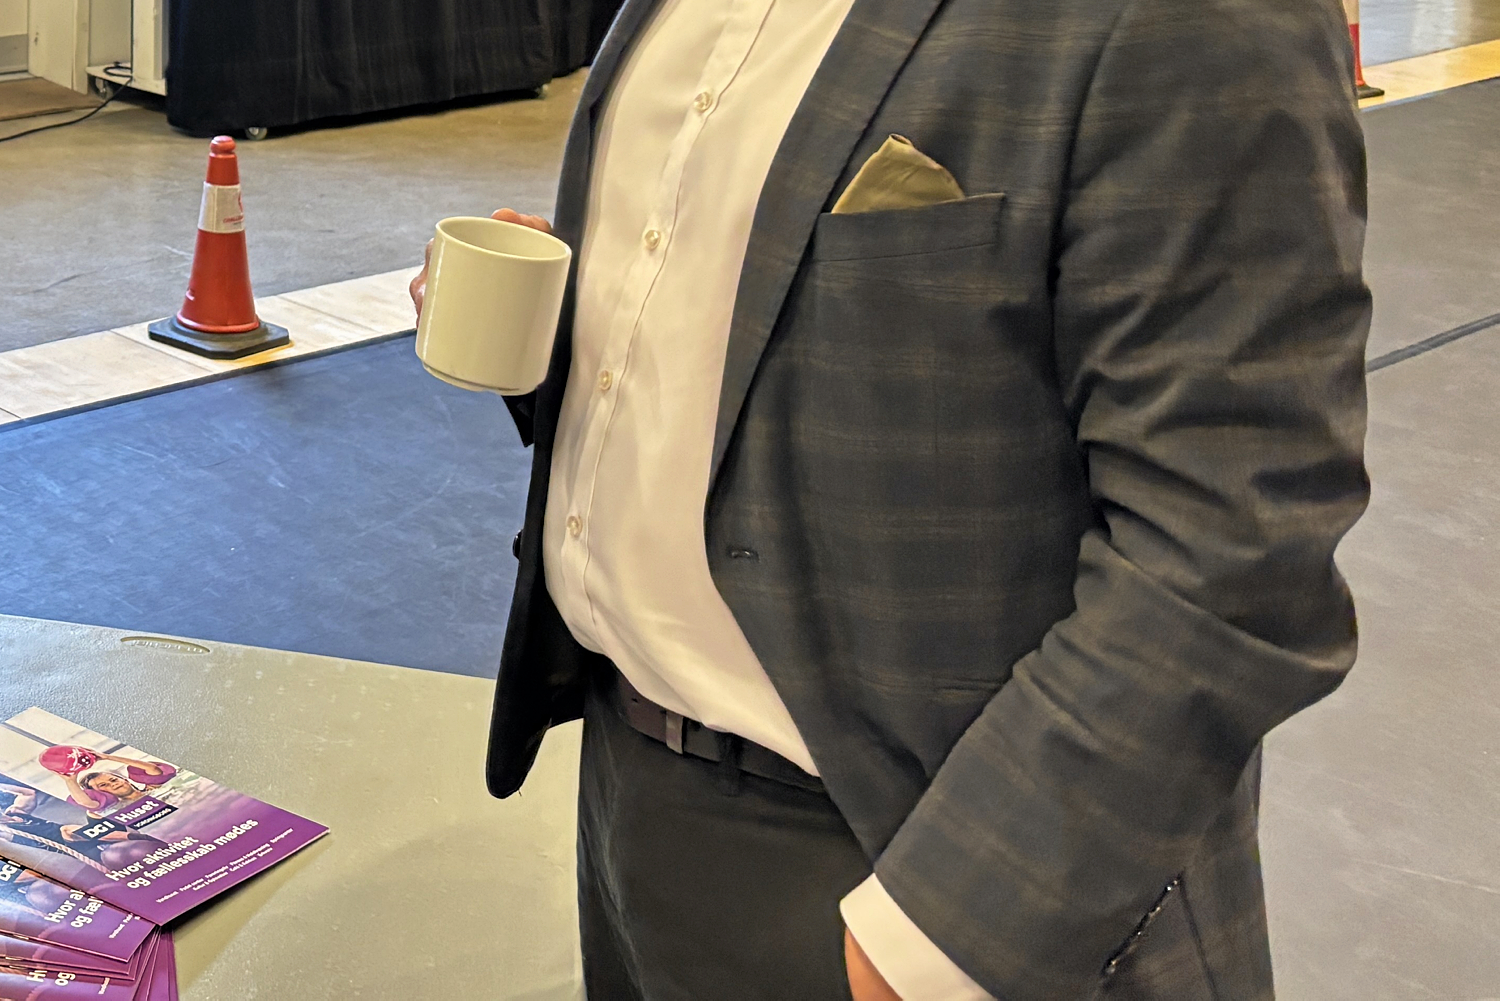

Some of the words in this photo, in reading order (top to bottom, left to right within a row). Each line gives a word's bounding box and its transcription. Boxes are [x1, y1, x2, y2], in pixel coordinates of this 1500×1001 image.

[114, 800, 160, 823] Huset
[83, 820, 115, 839] DGI
[105, 861, 144, 881] Hvor
[142, 836, 199, 865] aktivitet
[127, 876, 151, 889] og
[148, 842, 217, 880] fællesskab
[213, 818, 259, 846] mødes
[44, 900, 76, 923] Hvor
[70, 915, 93, 928] og
[54, 972, 76, 986] og
